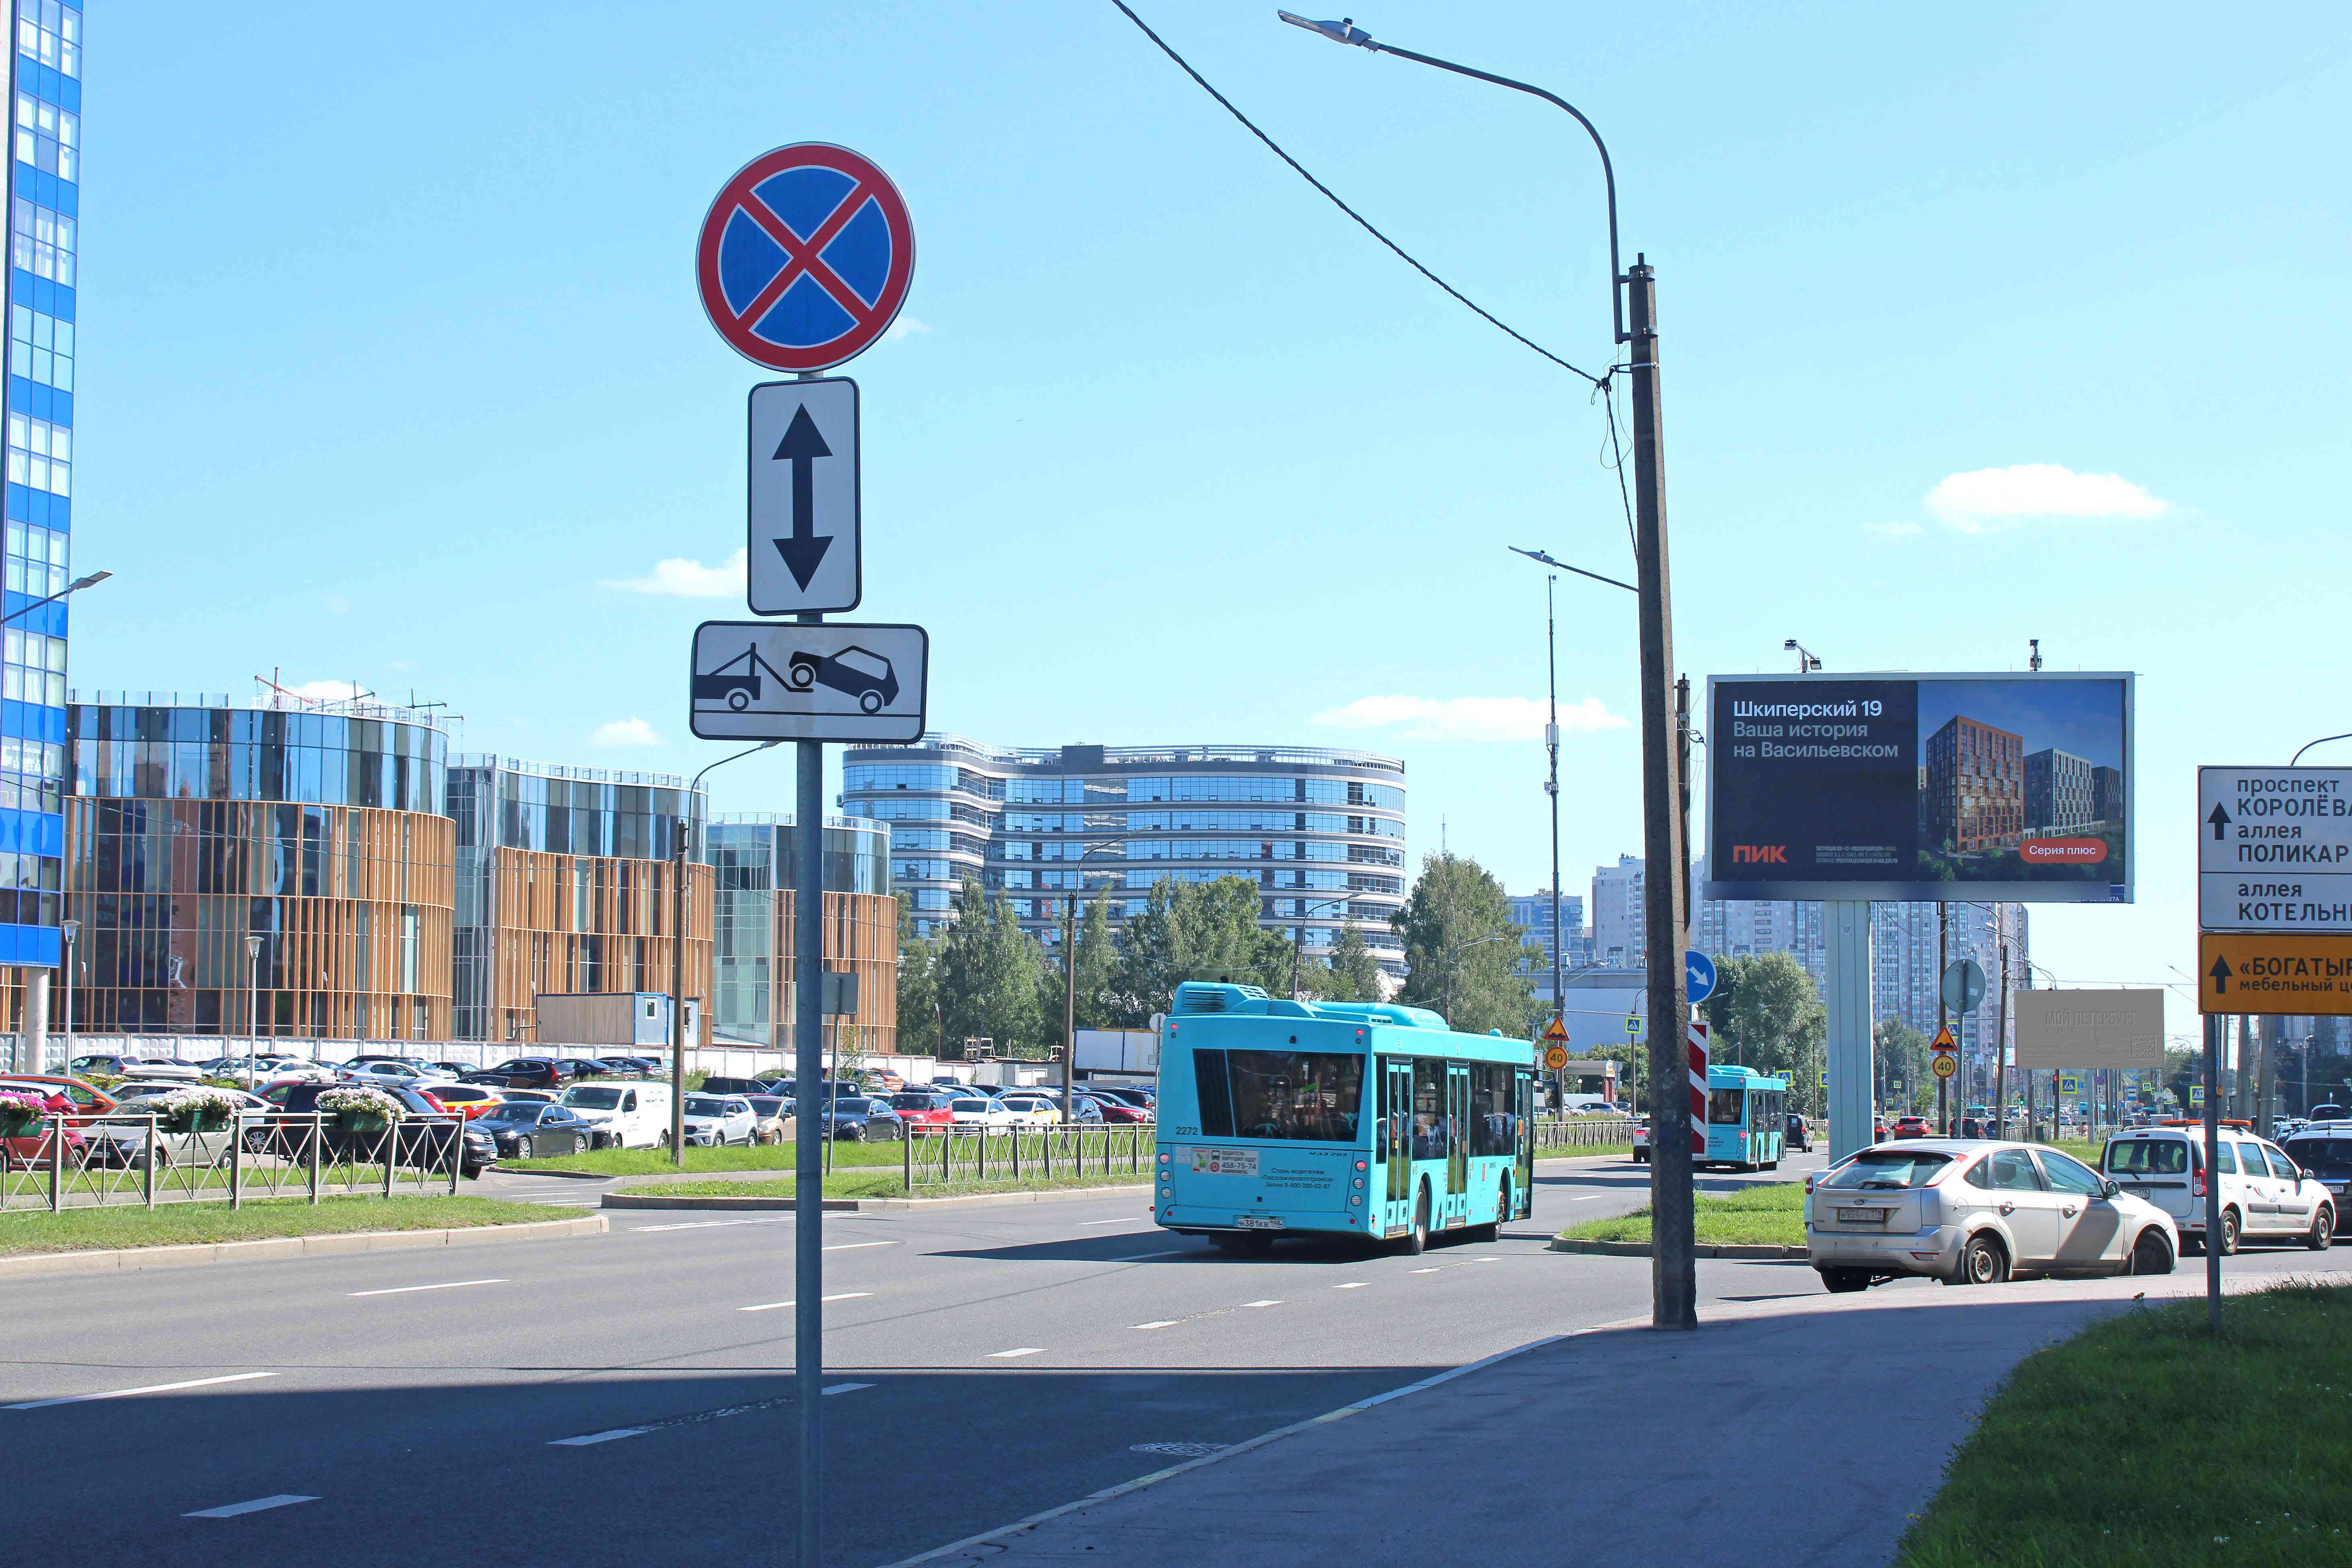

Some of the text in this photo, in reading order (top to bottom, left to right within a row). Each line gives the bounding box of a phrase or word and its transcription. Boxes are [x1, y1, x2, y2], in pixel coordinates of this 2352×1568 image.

[1734, 700, 1882, 720] Шкиперский 19
[1734, 721, 1868, 740] Ваша история
[1734, 742, 1898, 757] на Васильевском
[2237, 779, 2340, 797] проспект
[2237, 794, 2352, 817] КОРОЛЁВ
[2238, 825, 2301, 839] аллея
[1733, 845, 1788, 863] ПИК
[2029, 845, 2064, 857] Серия
[2239, 844, 2352, 863] ПОЛИКАР
[2238, 884, 2301, 897] аллея
[2239, 903, 2352, 921] КОТЕЛЬН
[2240, 977, 2352, 993] мебельный ц
[2046, 1008, 2138, 1026] МОЙ ПЕТЕРБУРГ
[1550, 1053, 1563, 1062] 40
[1938, 1062, 1950, 1071] 40
[1176, 1126, 1198, 1135] 2272
